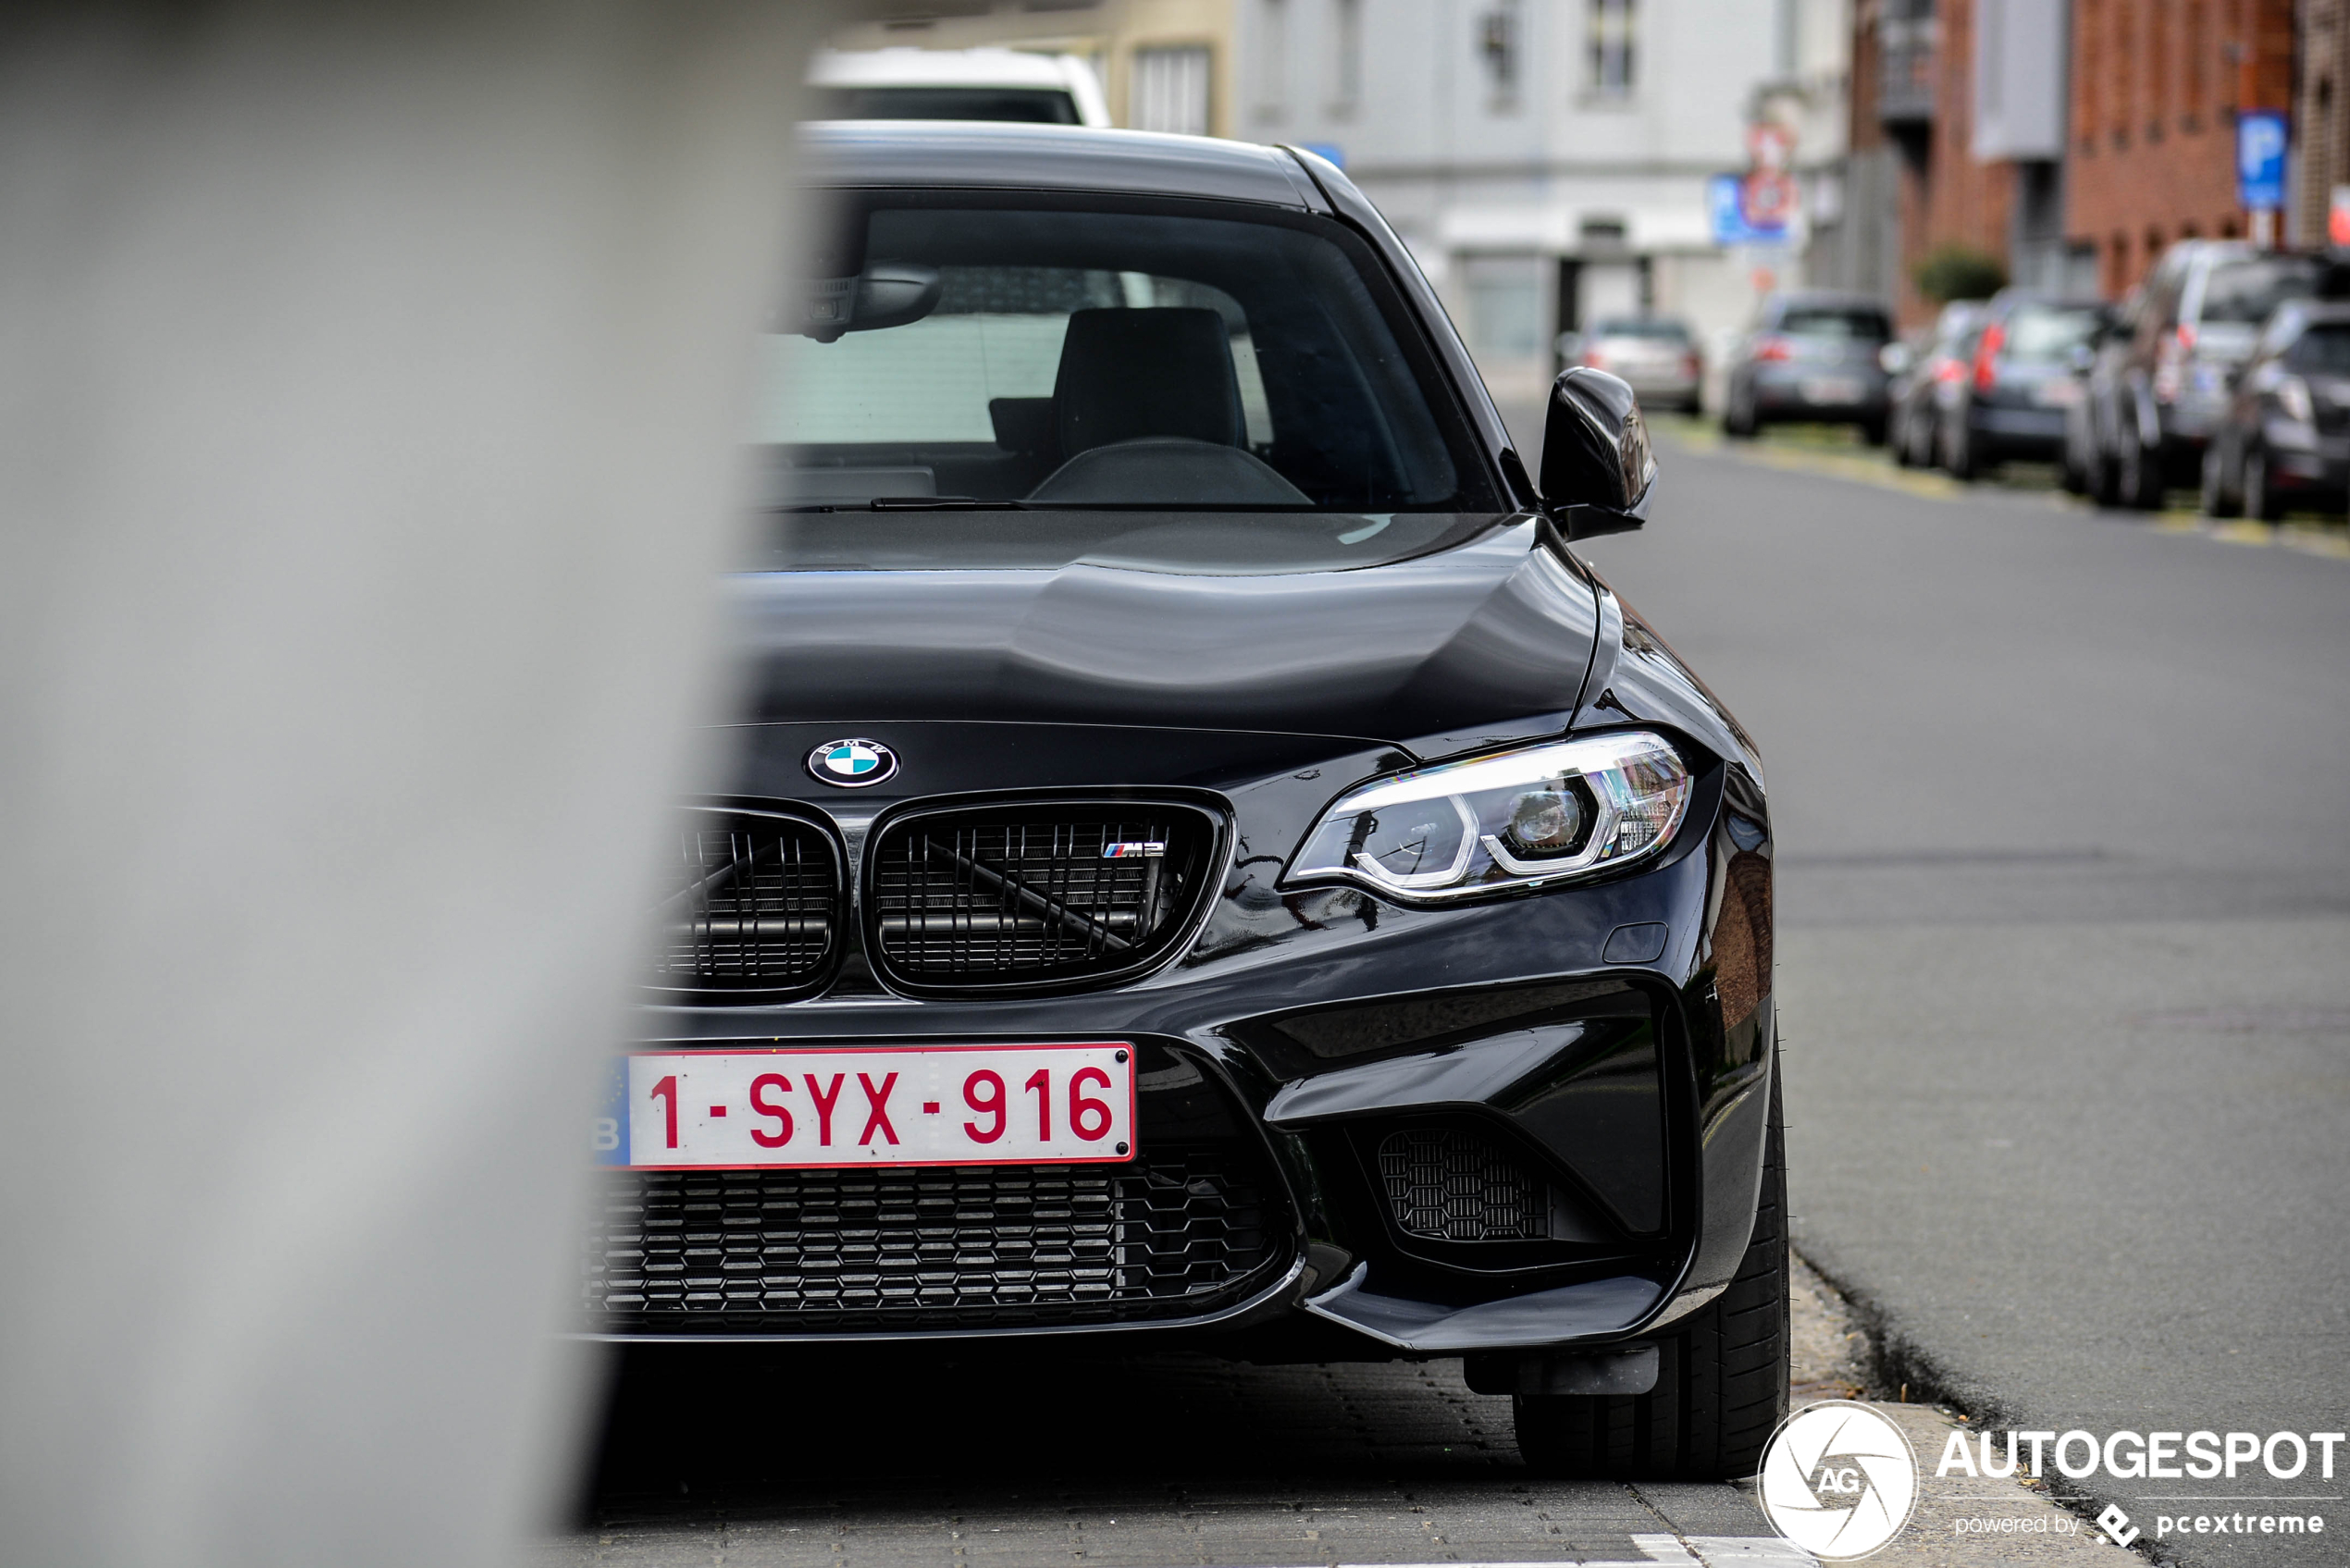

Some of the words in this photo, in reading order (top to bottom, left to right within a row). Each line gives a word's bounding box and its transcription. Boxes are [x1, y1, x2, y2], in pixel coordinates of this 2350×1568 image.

[817, 740, 887, 754] BMW
[1120, 843, 1164, 858] M2
[592, 1117, 620, 1151] B
